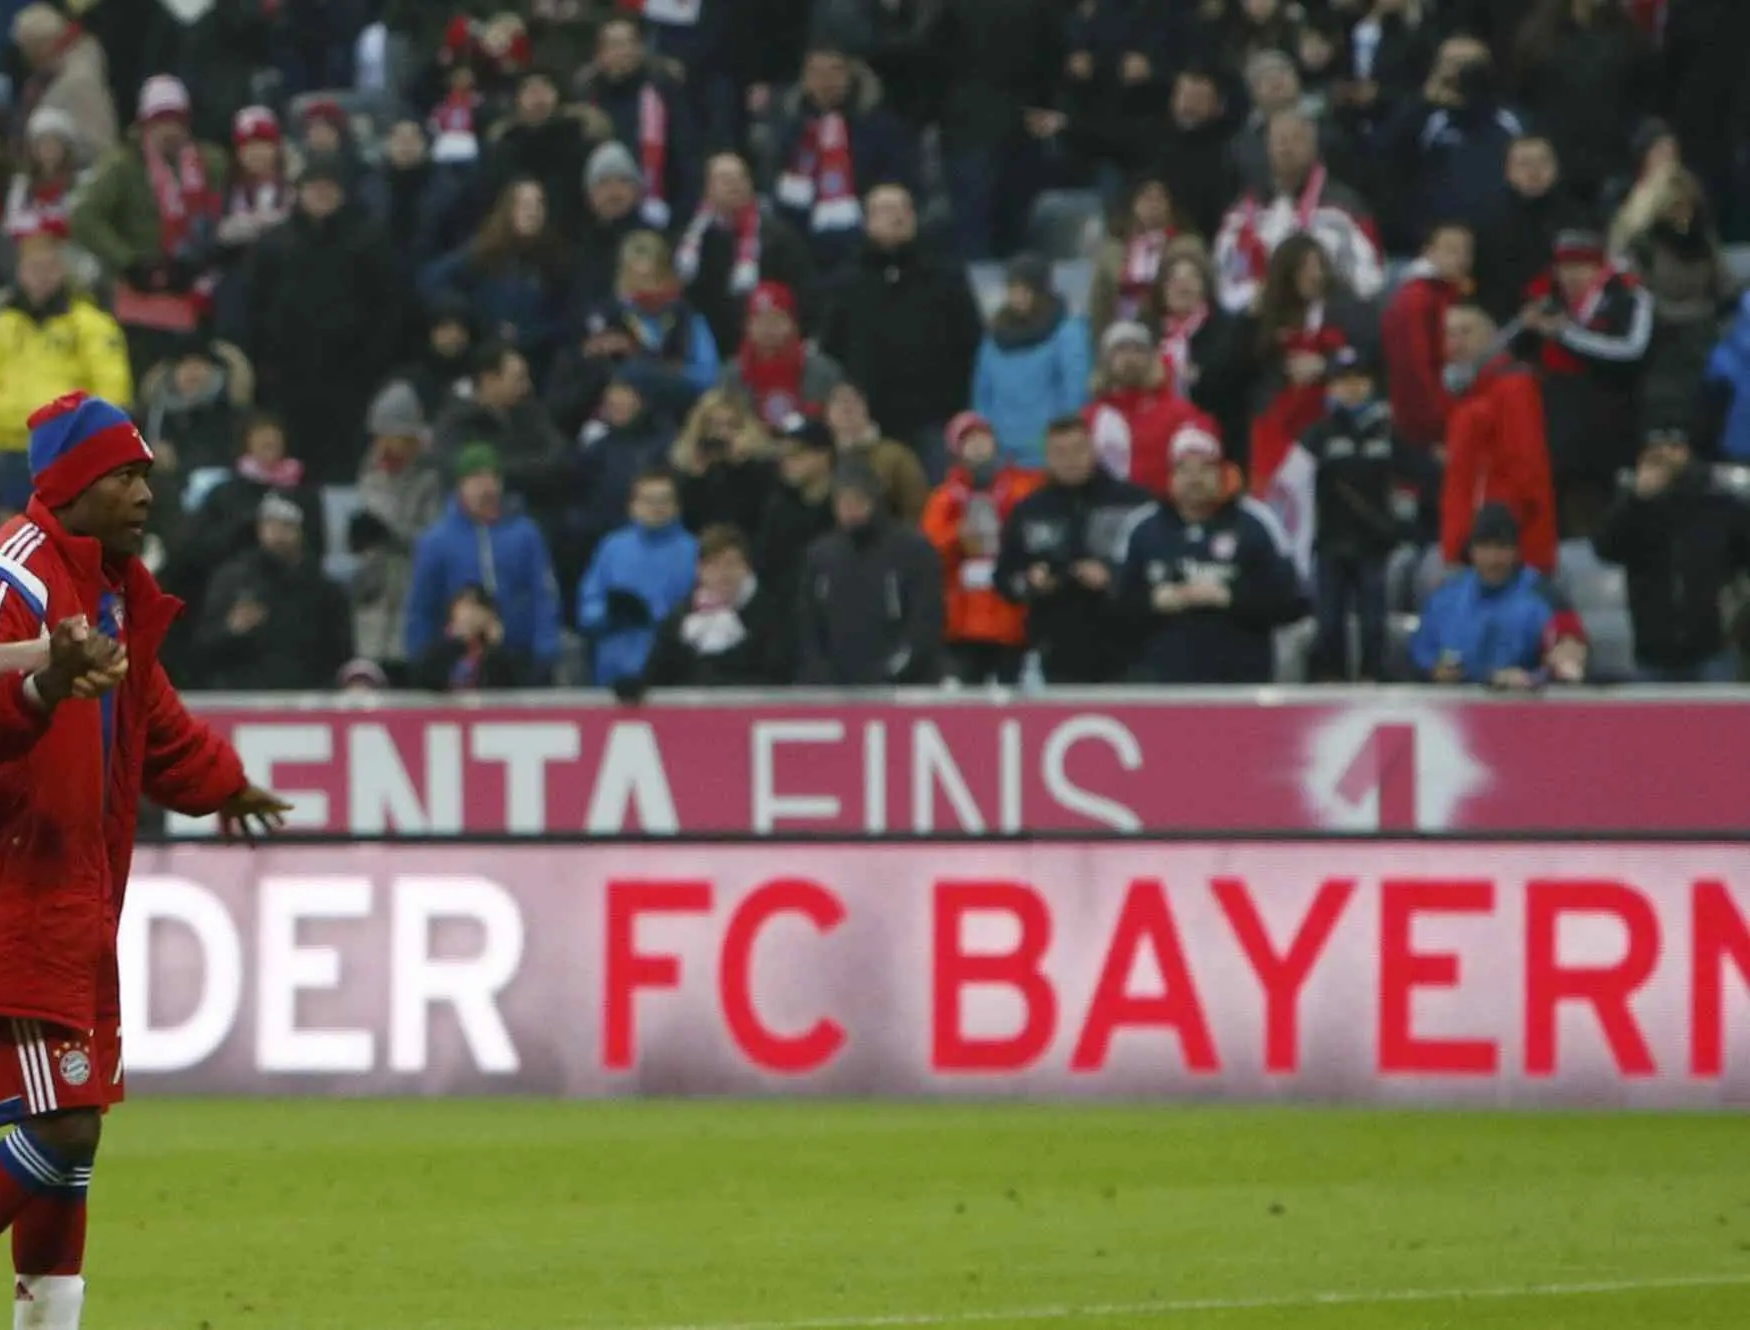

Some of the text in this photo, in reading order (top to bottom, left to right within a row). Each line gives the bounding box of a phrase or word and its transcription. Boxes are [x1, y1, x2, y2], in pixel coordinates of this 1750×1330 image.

[165, 722, 681, 836] ENTA
[117, 875, 524, 1073] DER
[601, 877, 847, 1074] FC
